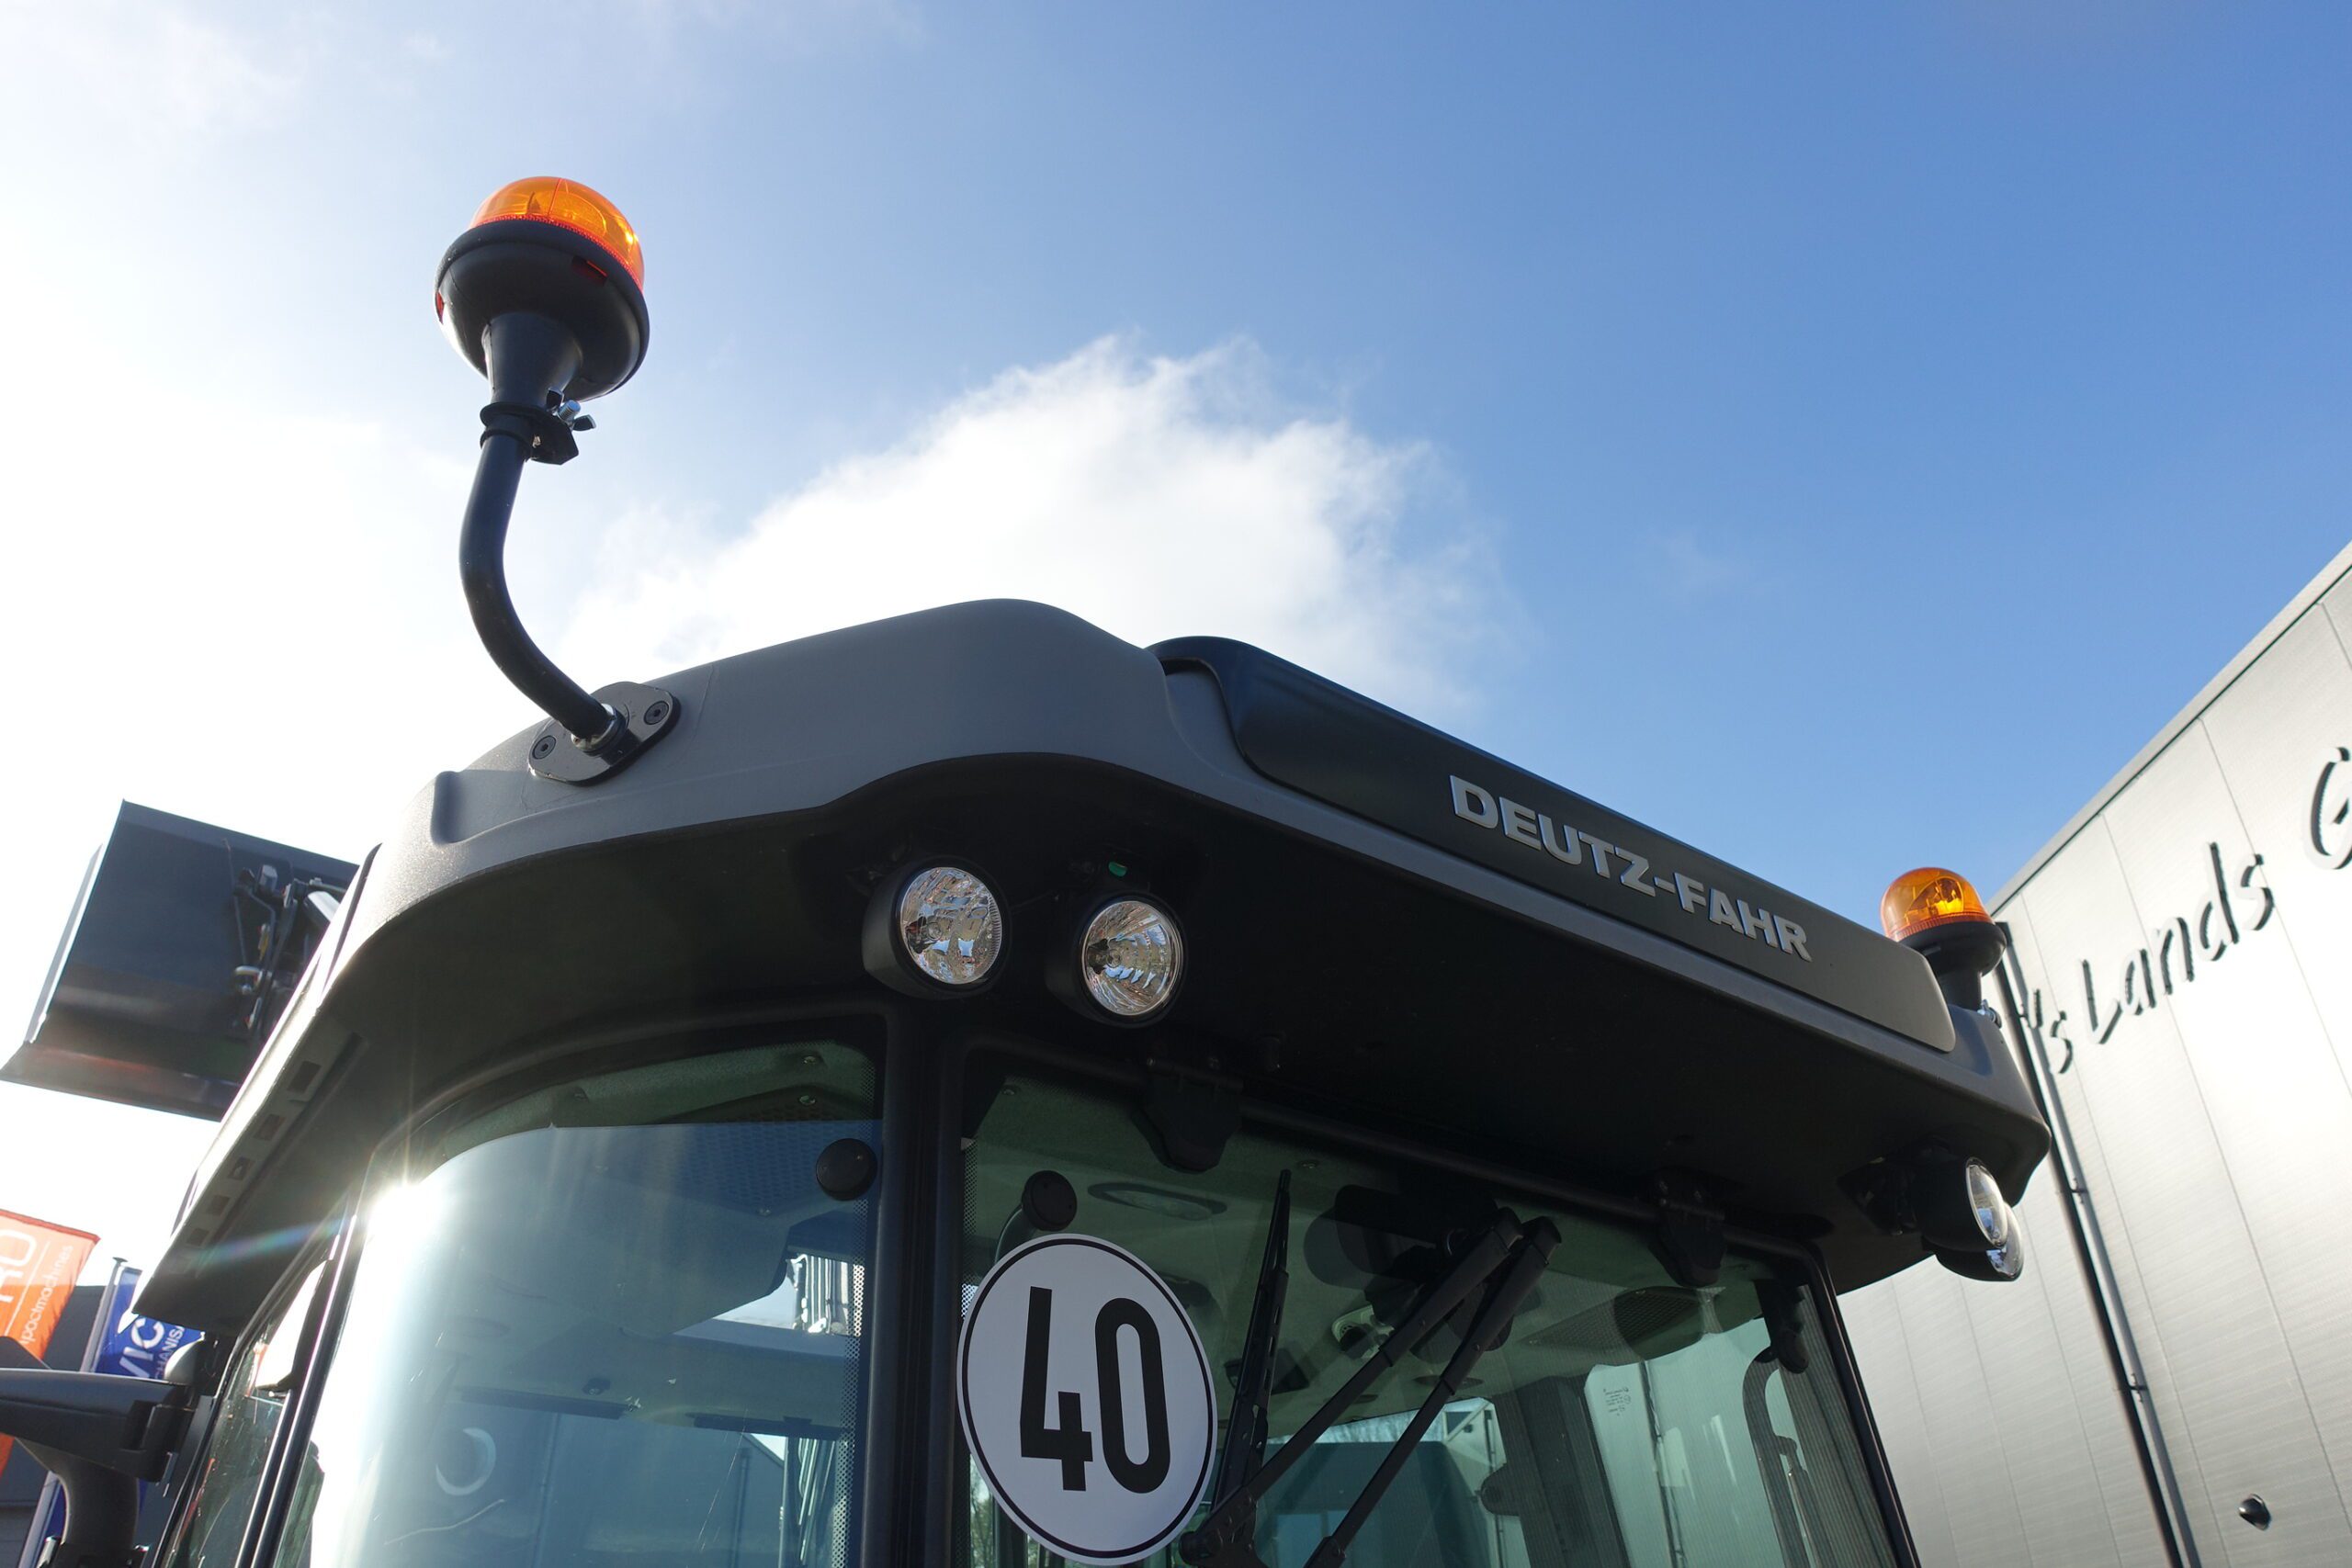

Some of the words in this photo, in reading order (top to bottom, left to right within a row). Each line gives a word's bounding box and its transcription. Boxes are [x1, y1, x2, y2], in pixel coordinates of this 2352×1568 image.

[1449, 774, 1813, 963] DEUTZ-FAHR
[2079, 840, 2276, 1045] Lands
[1020, 1286, 1170, 1494] 40
